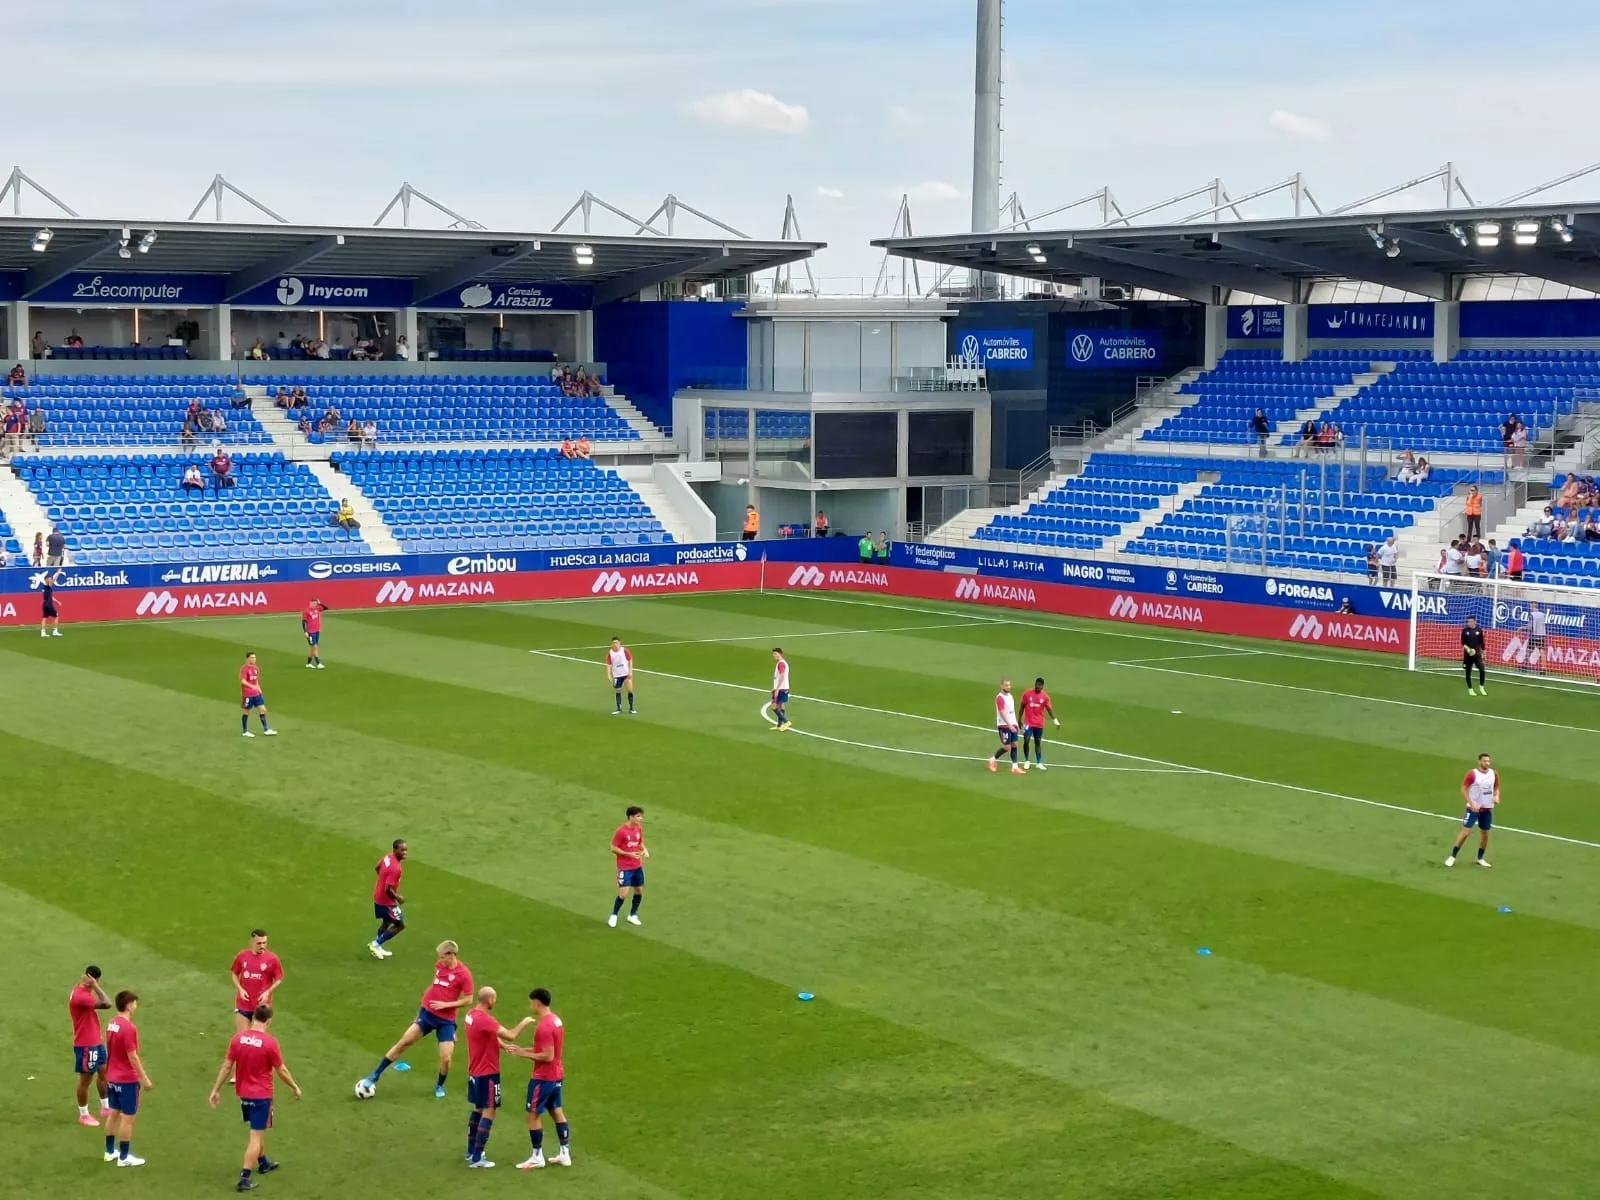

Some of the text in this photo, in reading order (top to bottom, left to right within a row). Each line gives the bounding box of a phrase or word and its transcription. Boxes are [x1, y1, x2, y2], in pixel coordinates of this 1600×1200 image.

[308, 284, 368, 299] Inycom
[508, 286, 541, 296] Cereales
[494, 293, 553, 308] Arasanz
[983, 337, 1019, 346] Automóviles
[1100, 336, 1146, 346] Automóviles
[986, 347, 1028, 360] CABRERO
[1103, 347, 1156, 359] CABRERO
[676, 546, 733, 564] podoactiva
[915, 546, 956, 560] federópticos
[333, 562, 402, 574] COSEHISA
[447, 553, 517, 575] embou
[978, 557, 1045, 572] LILLAS PASTIA
[53, 570, 129, 587] CaixaBank
[181, 563, 259, 583] CLAVERIA
[630, 572, 699, 587] MAZANA
[829, 569, 889, 586] MAZANA
[419, 581, 495, 598] MAZANA
[983, 584, 1037, 602] MAZANA
[1187, 582, 1224, 594] CABRERO
[1278, 584, 1334, 601] FORGASA
[183, 591, 268, 609] MAZANA
[1392, 594, 1449, 616] AMBAR
[1142, 602, 1204, 622] MAZANA
[1327, 622, 1400, 644] MAZANA
[88, 1050, 98, 1062] 16
